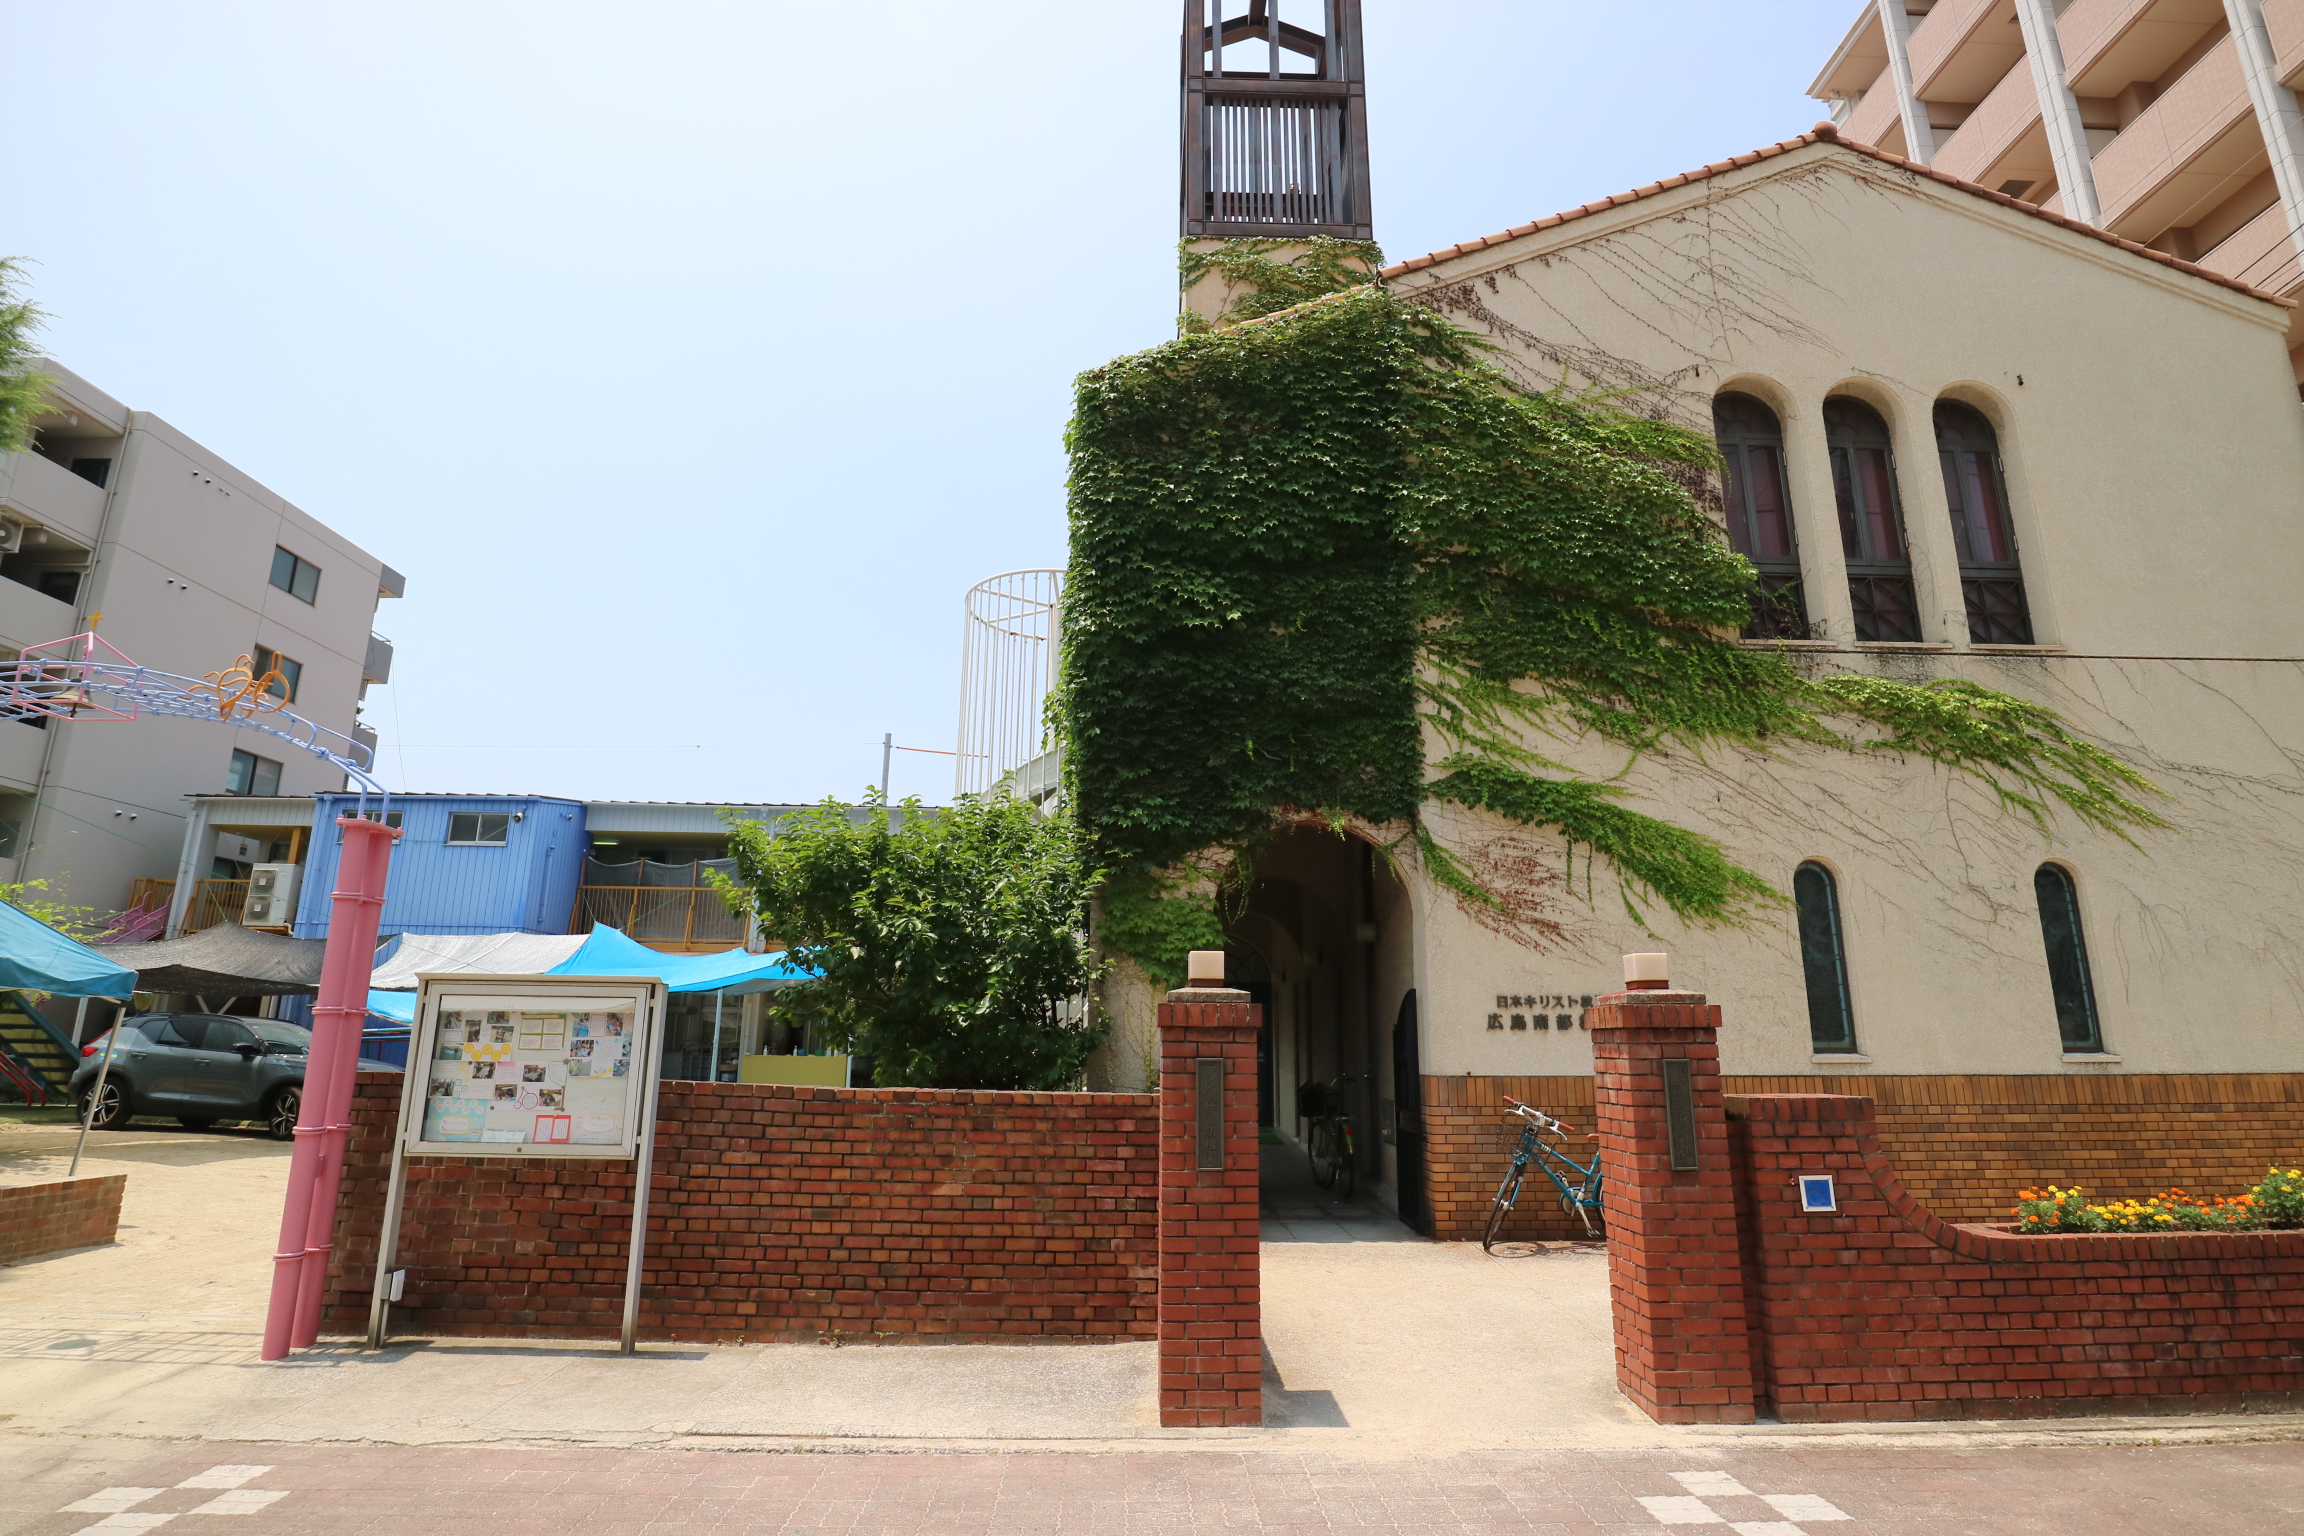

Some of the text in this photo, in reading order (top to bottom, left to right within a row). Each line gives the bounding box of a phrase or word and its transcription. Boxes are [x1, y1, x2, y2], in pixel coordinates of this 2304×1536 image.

[1496, 994, 1601, 1009] 日本キリスト教
[1486, 1012, 1584, 1031] 広島南部
[1203, 1065, 1217, 1164] フレーザー幼稚園
